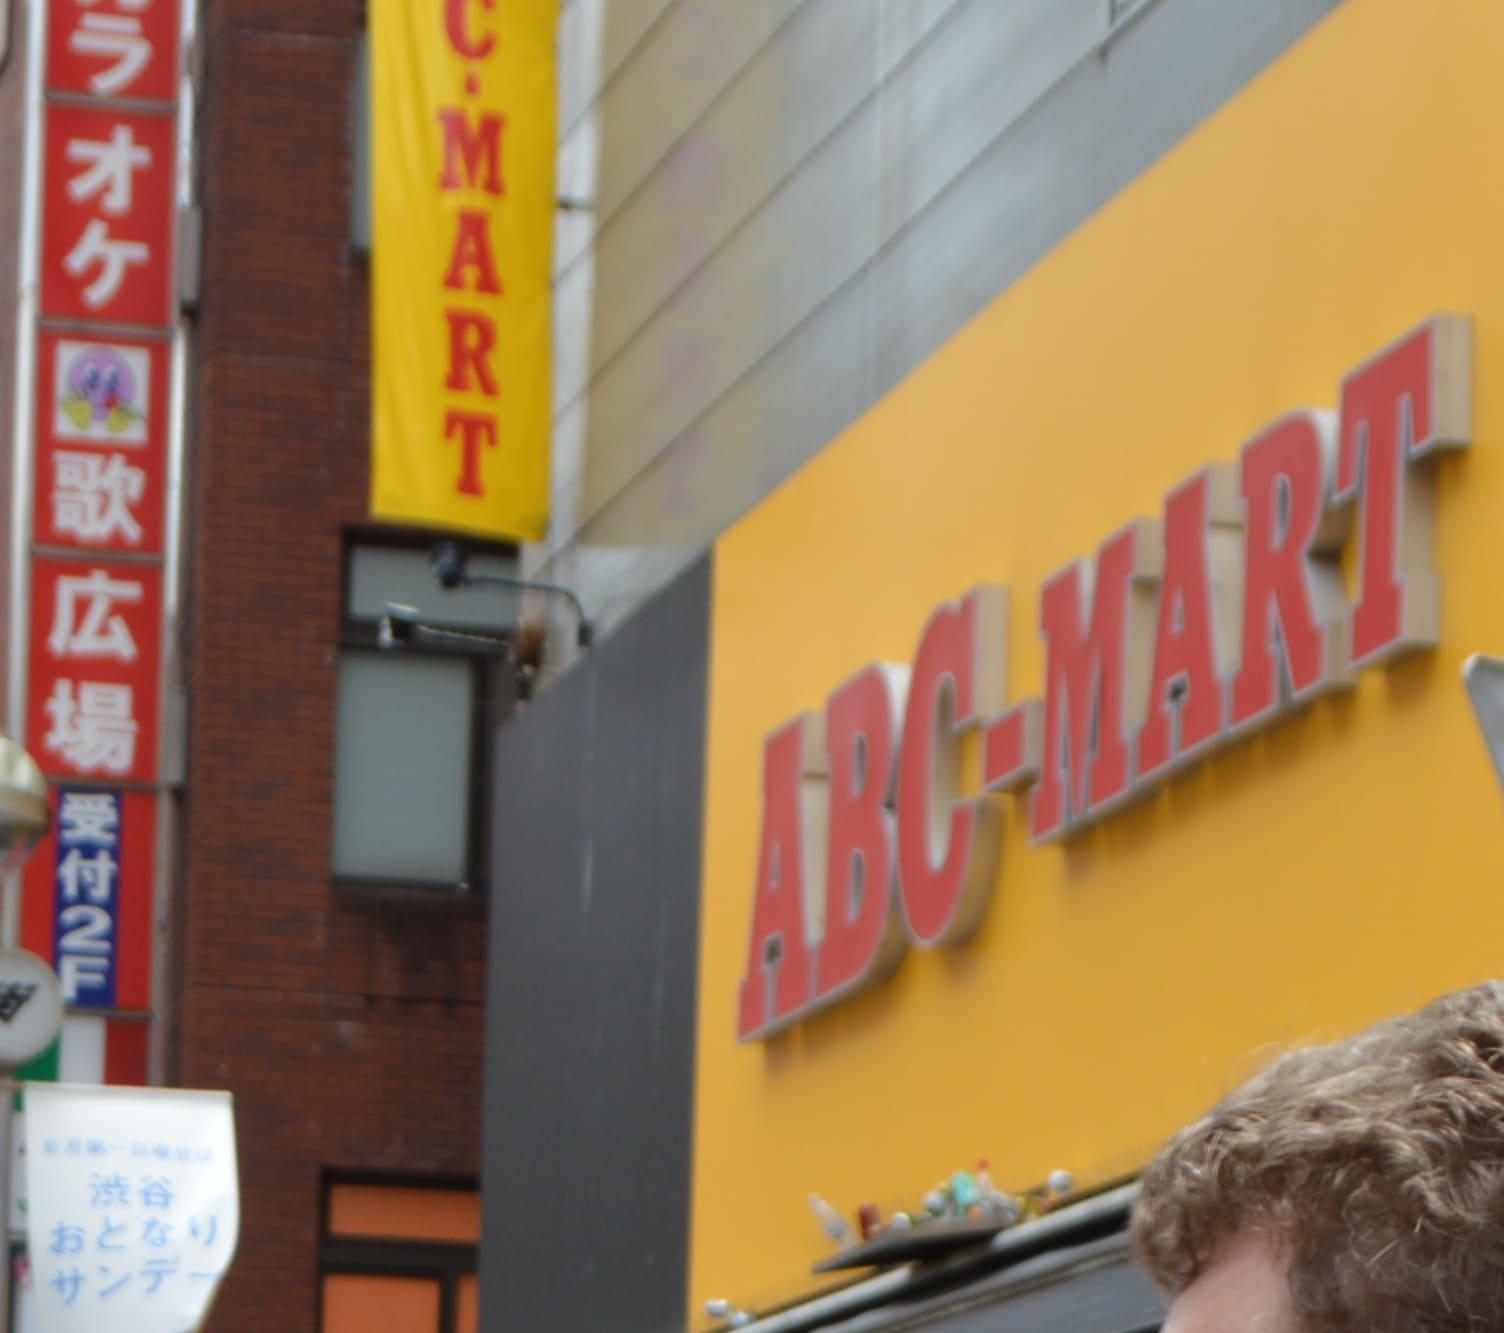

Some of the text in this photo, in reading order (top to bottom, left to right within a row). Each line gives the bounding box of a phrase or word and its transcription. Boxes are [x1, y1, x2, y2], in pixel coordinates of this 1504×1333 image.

[64, 0, 153, 312] ラオケ
[44, 448, 145, 777] 歌広場
[738, 318, 1462, 1042] ABC-MART
[58, 792, 121, 1003] 受付2F
[49, 1215, 218, 1254] おとなり
[49, 1256, 220, 1306] サンデー
[89, 1172, 174, 1208] 渋谷
